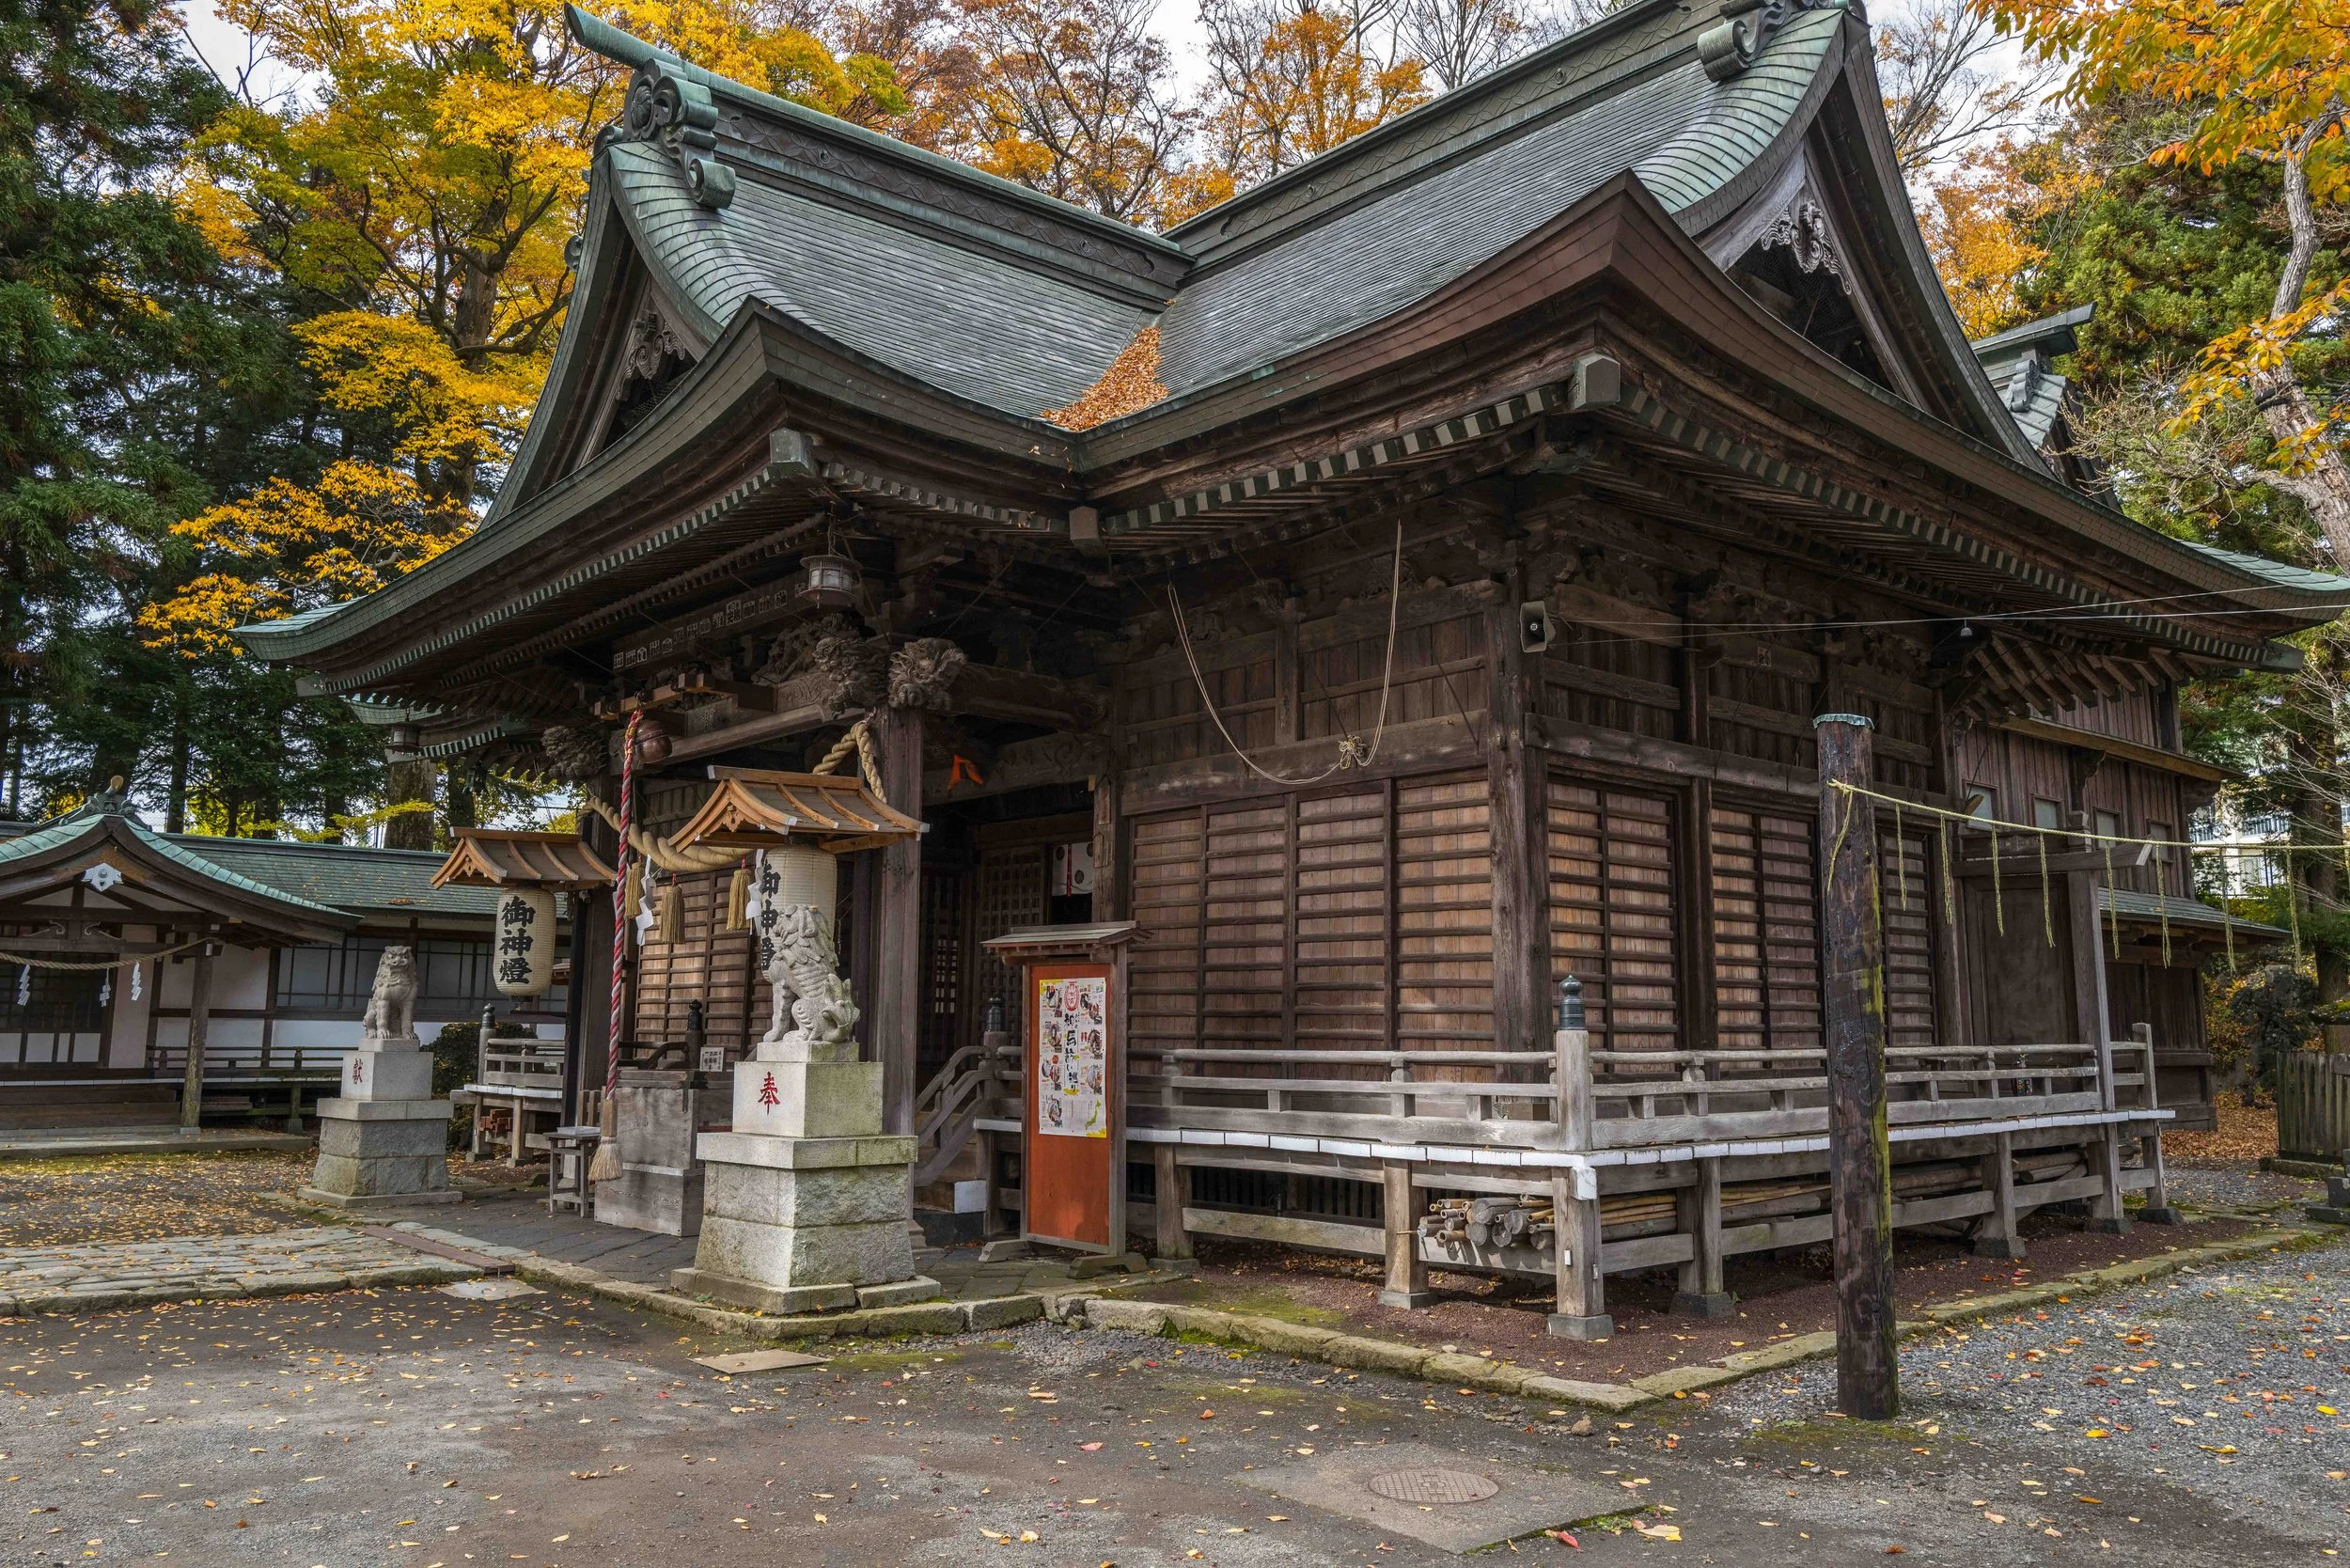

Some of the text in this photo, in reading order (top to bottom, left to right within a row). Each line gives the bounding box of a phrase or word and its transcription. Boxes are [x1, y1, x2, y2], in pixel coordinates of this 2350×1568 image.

[499, 895, 536, 984] 御神燈
[758, 1071, 781, 1116] 奉
